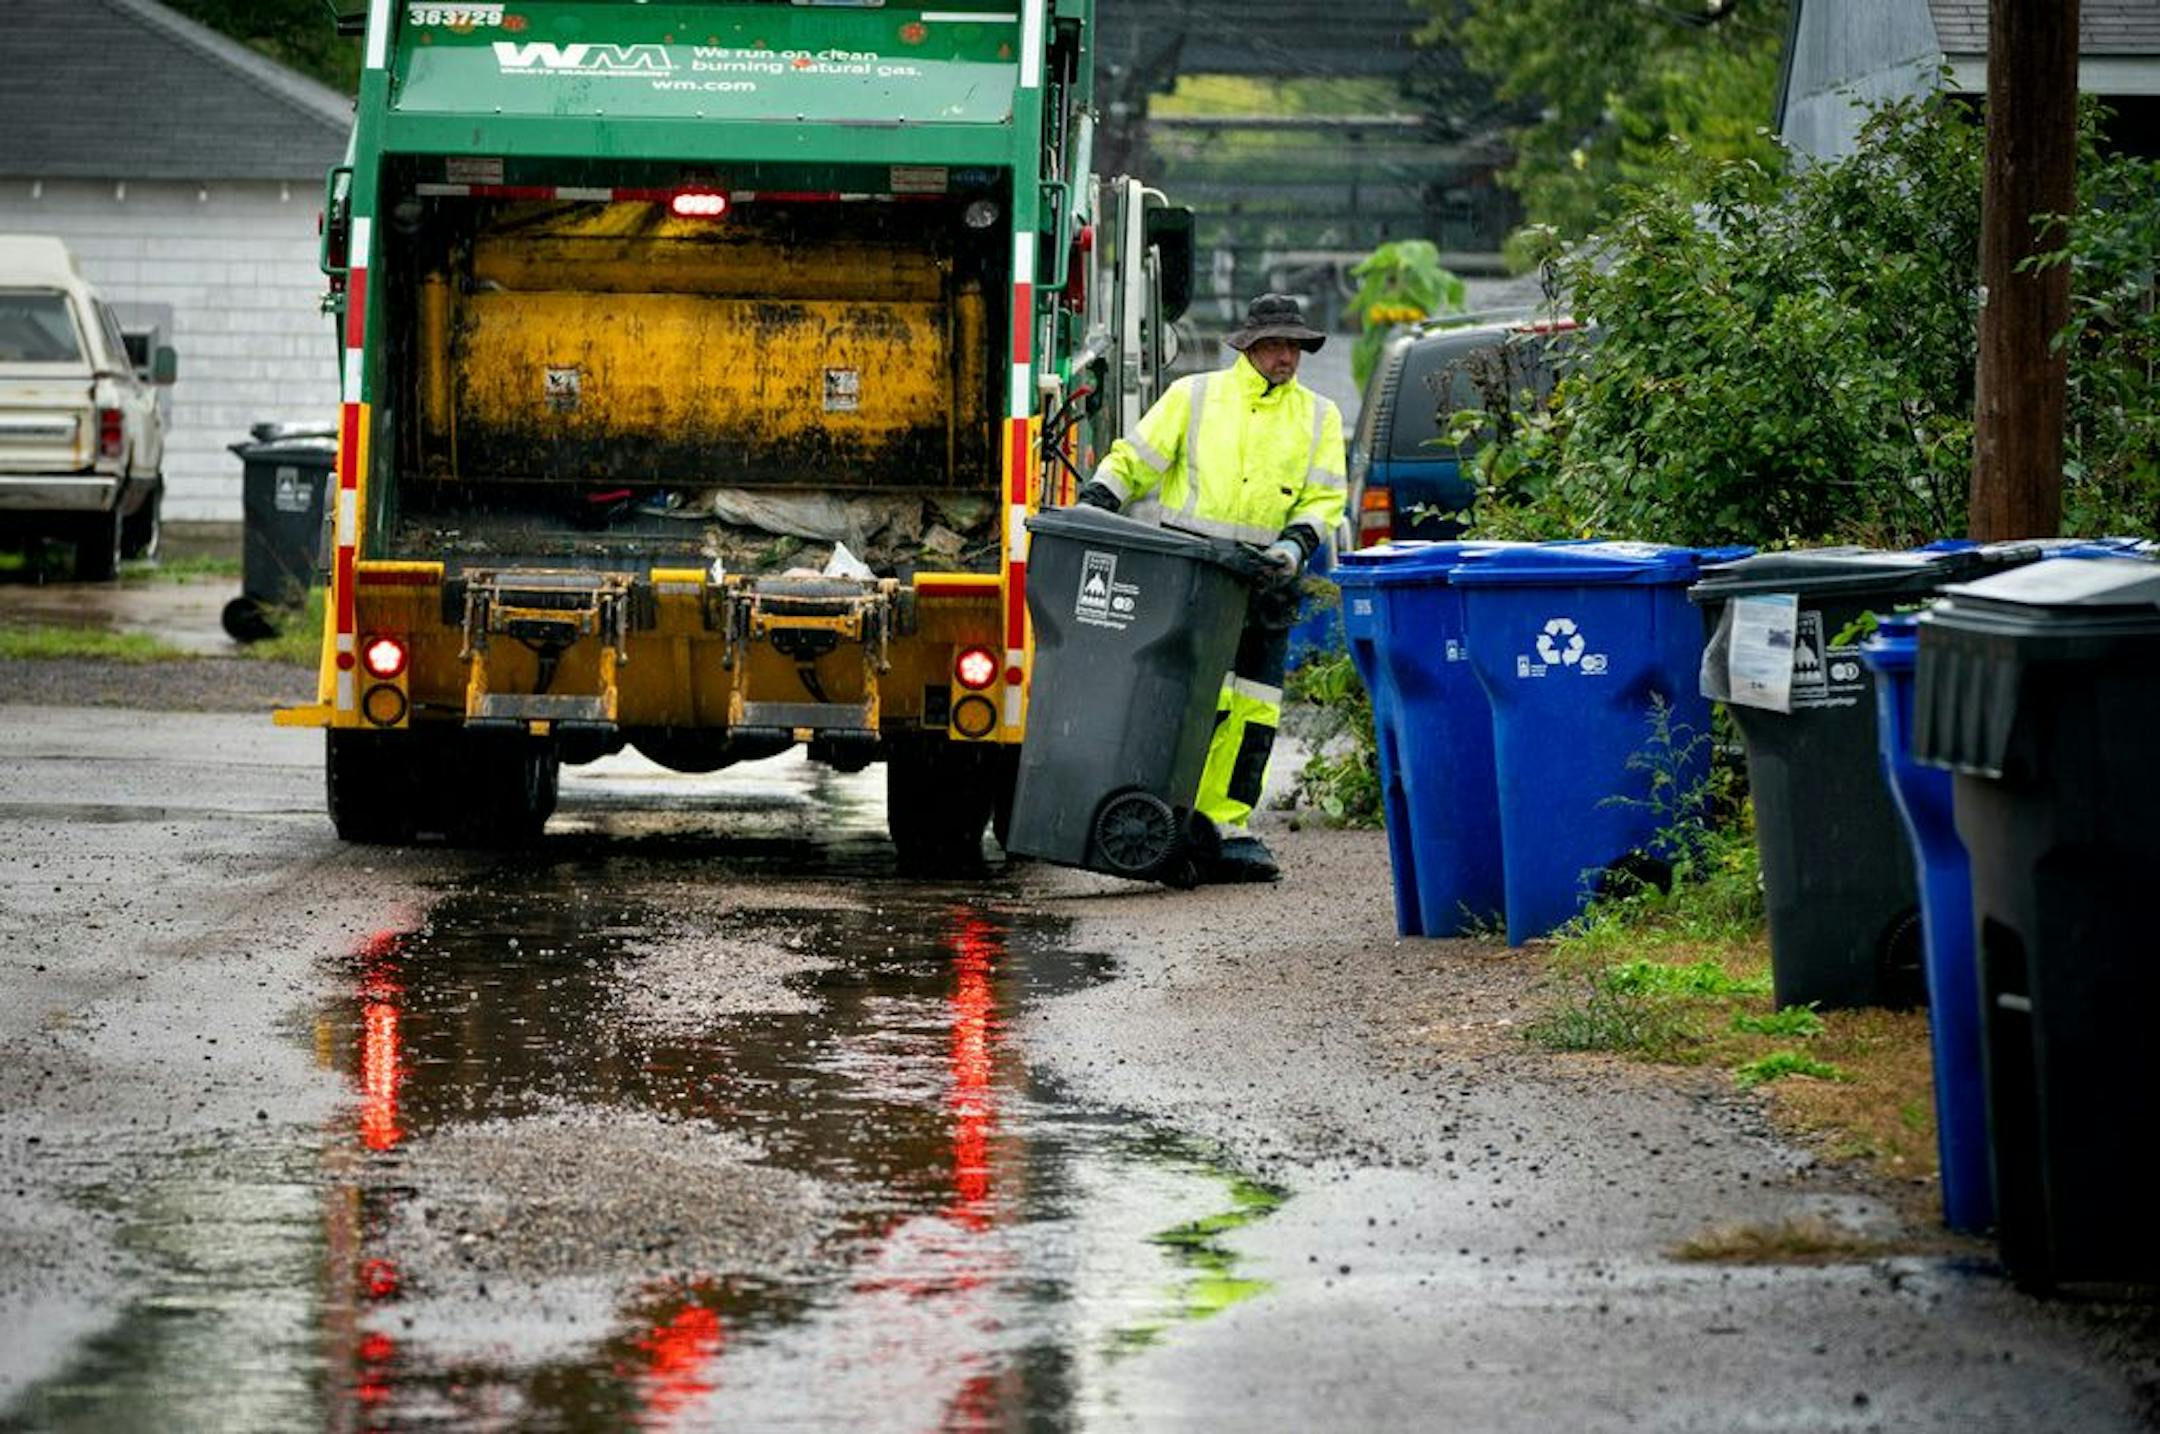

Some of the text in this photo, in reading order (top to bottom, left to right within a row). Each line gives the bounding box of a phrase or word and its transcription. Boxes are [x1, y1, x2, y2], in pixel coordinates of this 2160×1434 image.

[492, 42, 673, 69] WM
[693, 46, 879, 62] We run on clean
[691, 60, 784, 75] burning
[877, 65, 922, 78] gas.
[652, 80, 757, 93] wm.com
